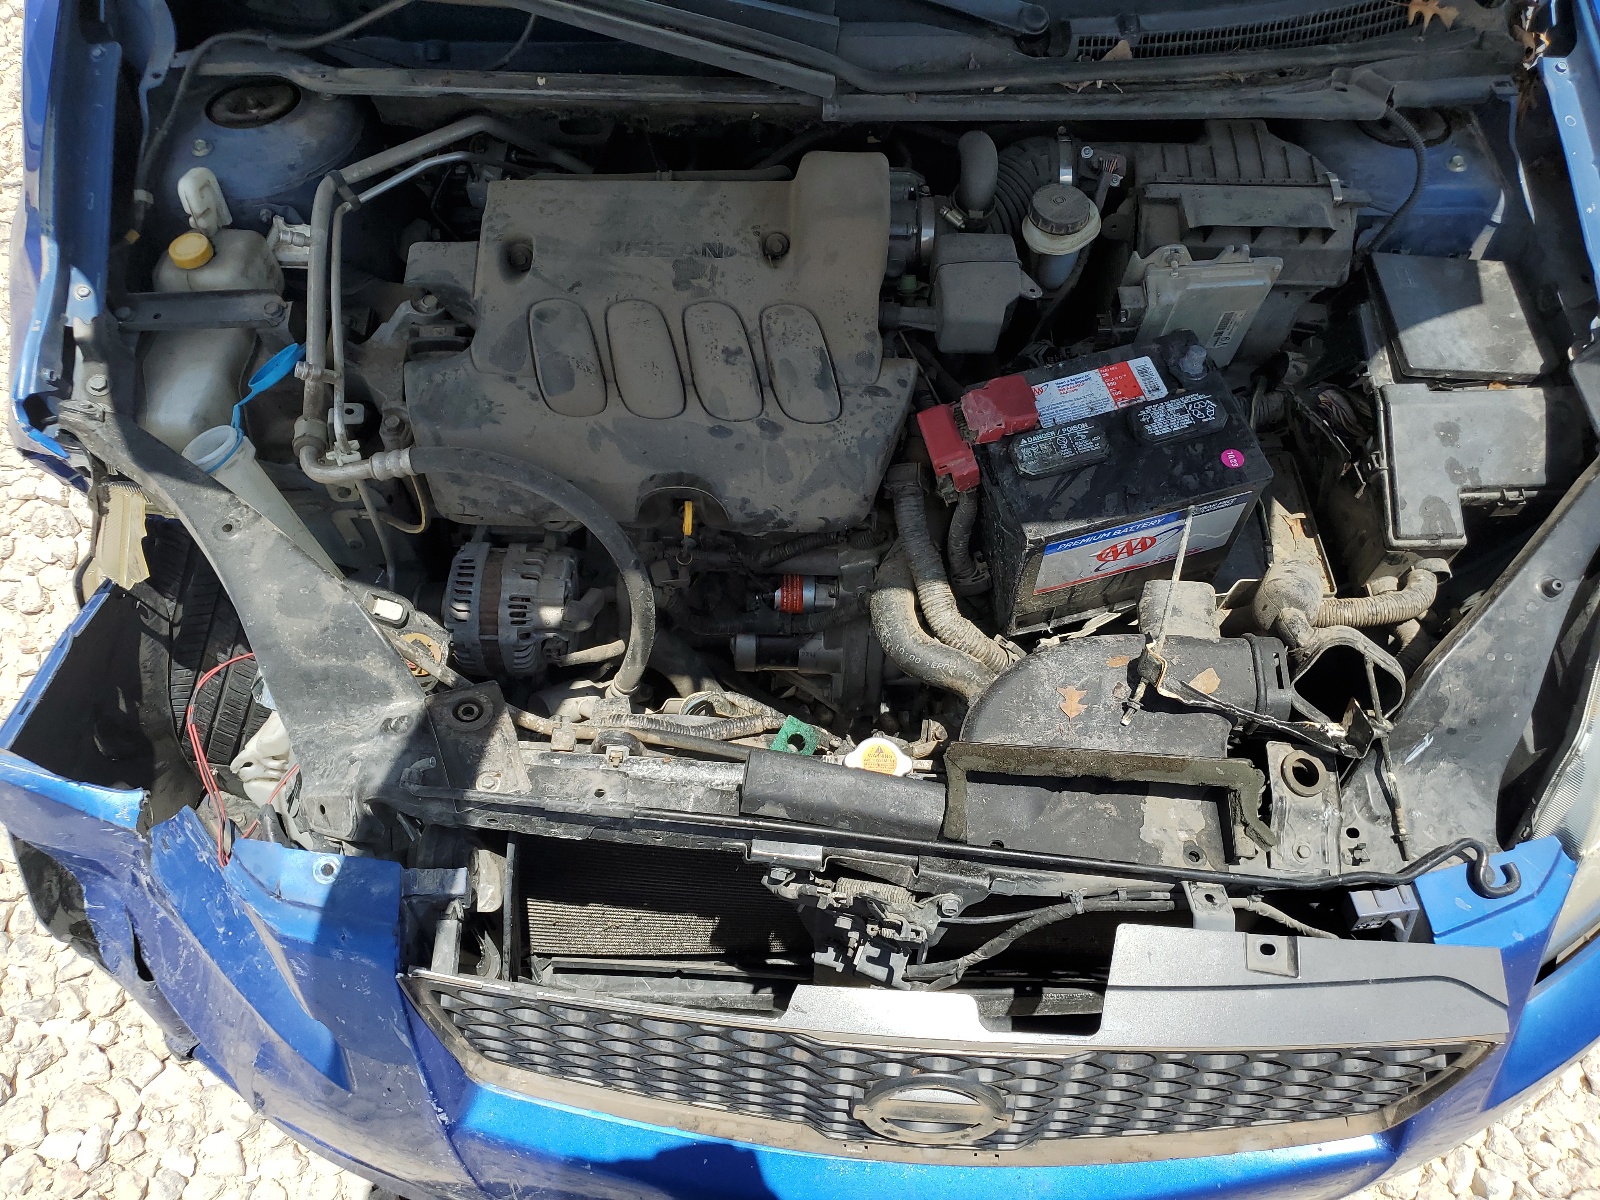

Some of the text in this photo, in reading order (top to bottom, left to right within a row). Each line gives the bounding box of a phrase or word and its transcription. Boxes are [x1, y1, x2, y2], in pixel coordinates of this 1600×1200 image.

[1027, 431, 1055, 443] DANGER
[1061, 422, 1088, 434] POISON
[1057, 517, 1166, 551] PREMIUM BATTERY
[1097, 536, 1157, 562] AAA
